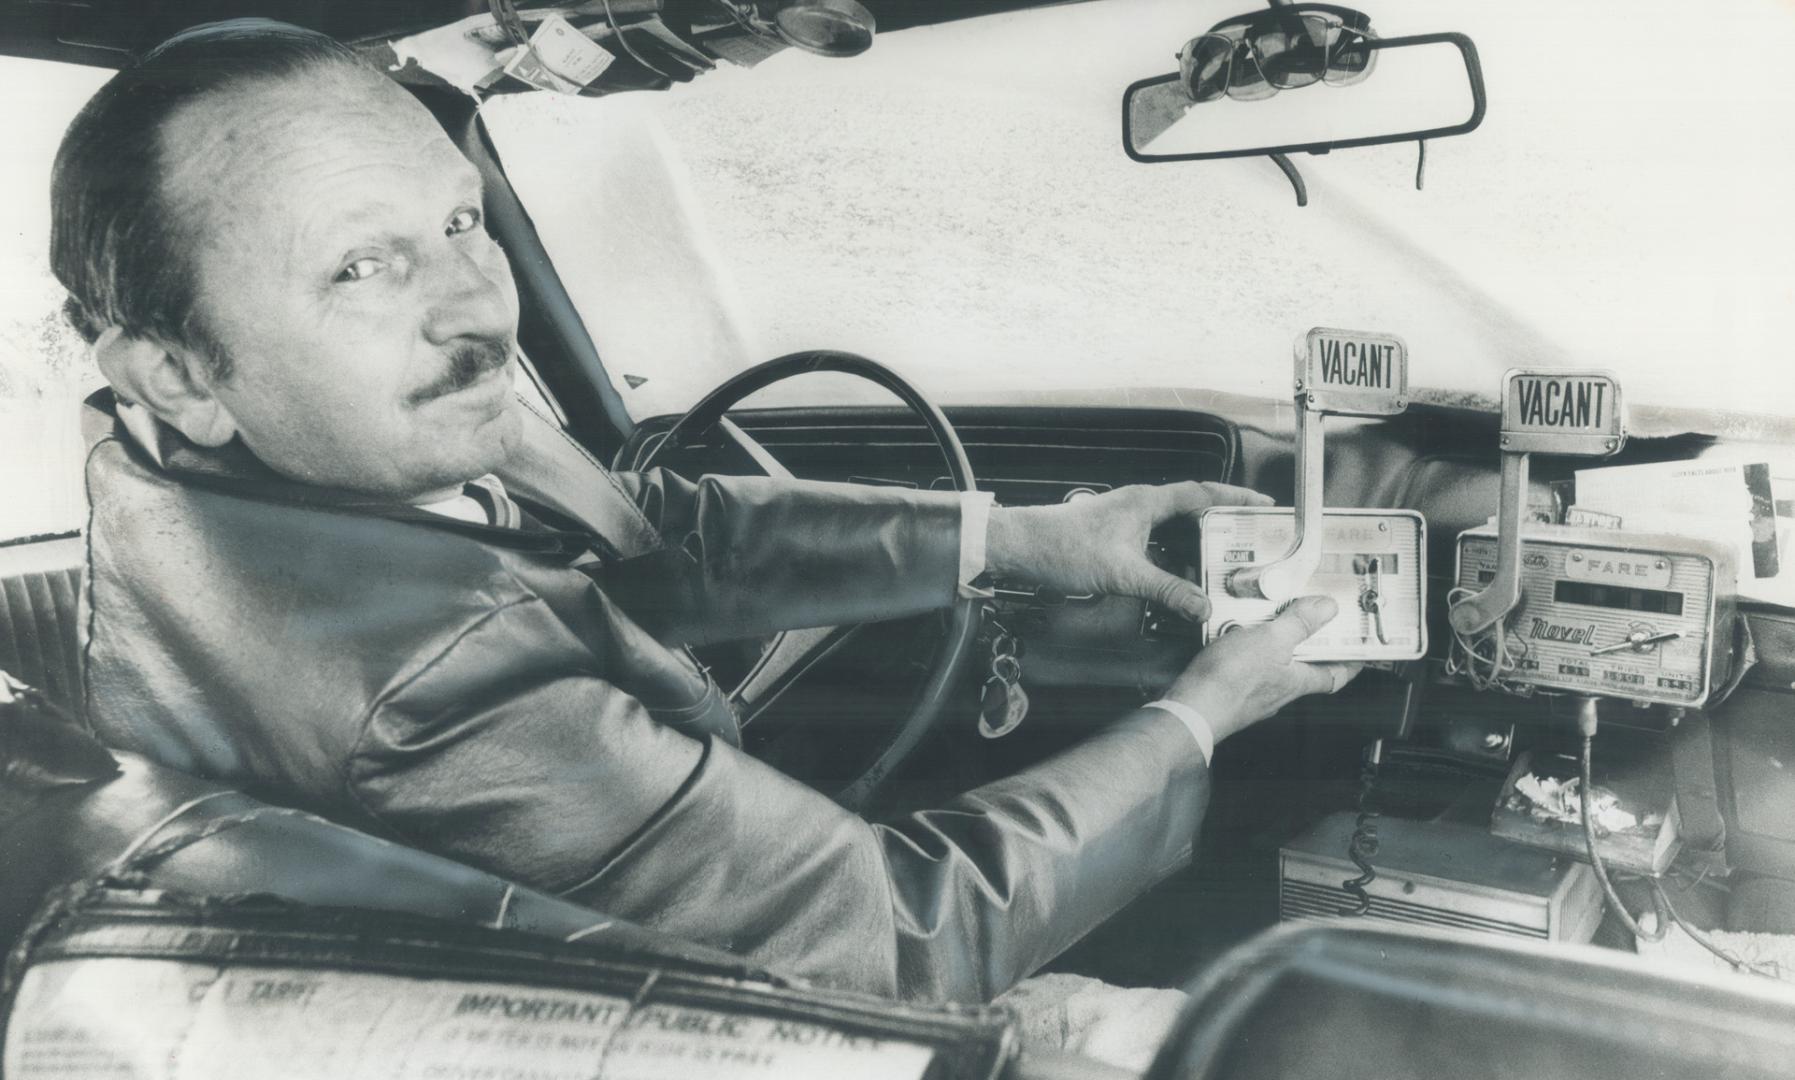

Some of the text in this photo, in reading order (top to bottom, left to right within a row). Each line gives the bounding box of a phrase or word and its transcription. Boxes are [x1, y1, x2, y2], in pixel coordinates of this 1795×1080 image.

[1319, 338, 1395, 389] VACANT
[1518, 379, 1608, 429] VACANT
[1224, 550, 1250, 562] VACANT
[1587, 559, 1649, 577] FARE
[1530, 617, 1596, 646] Novel
[456, 993, 616, 1024] IMPORTANT
